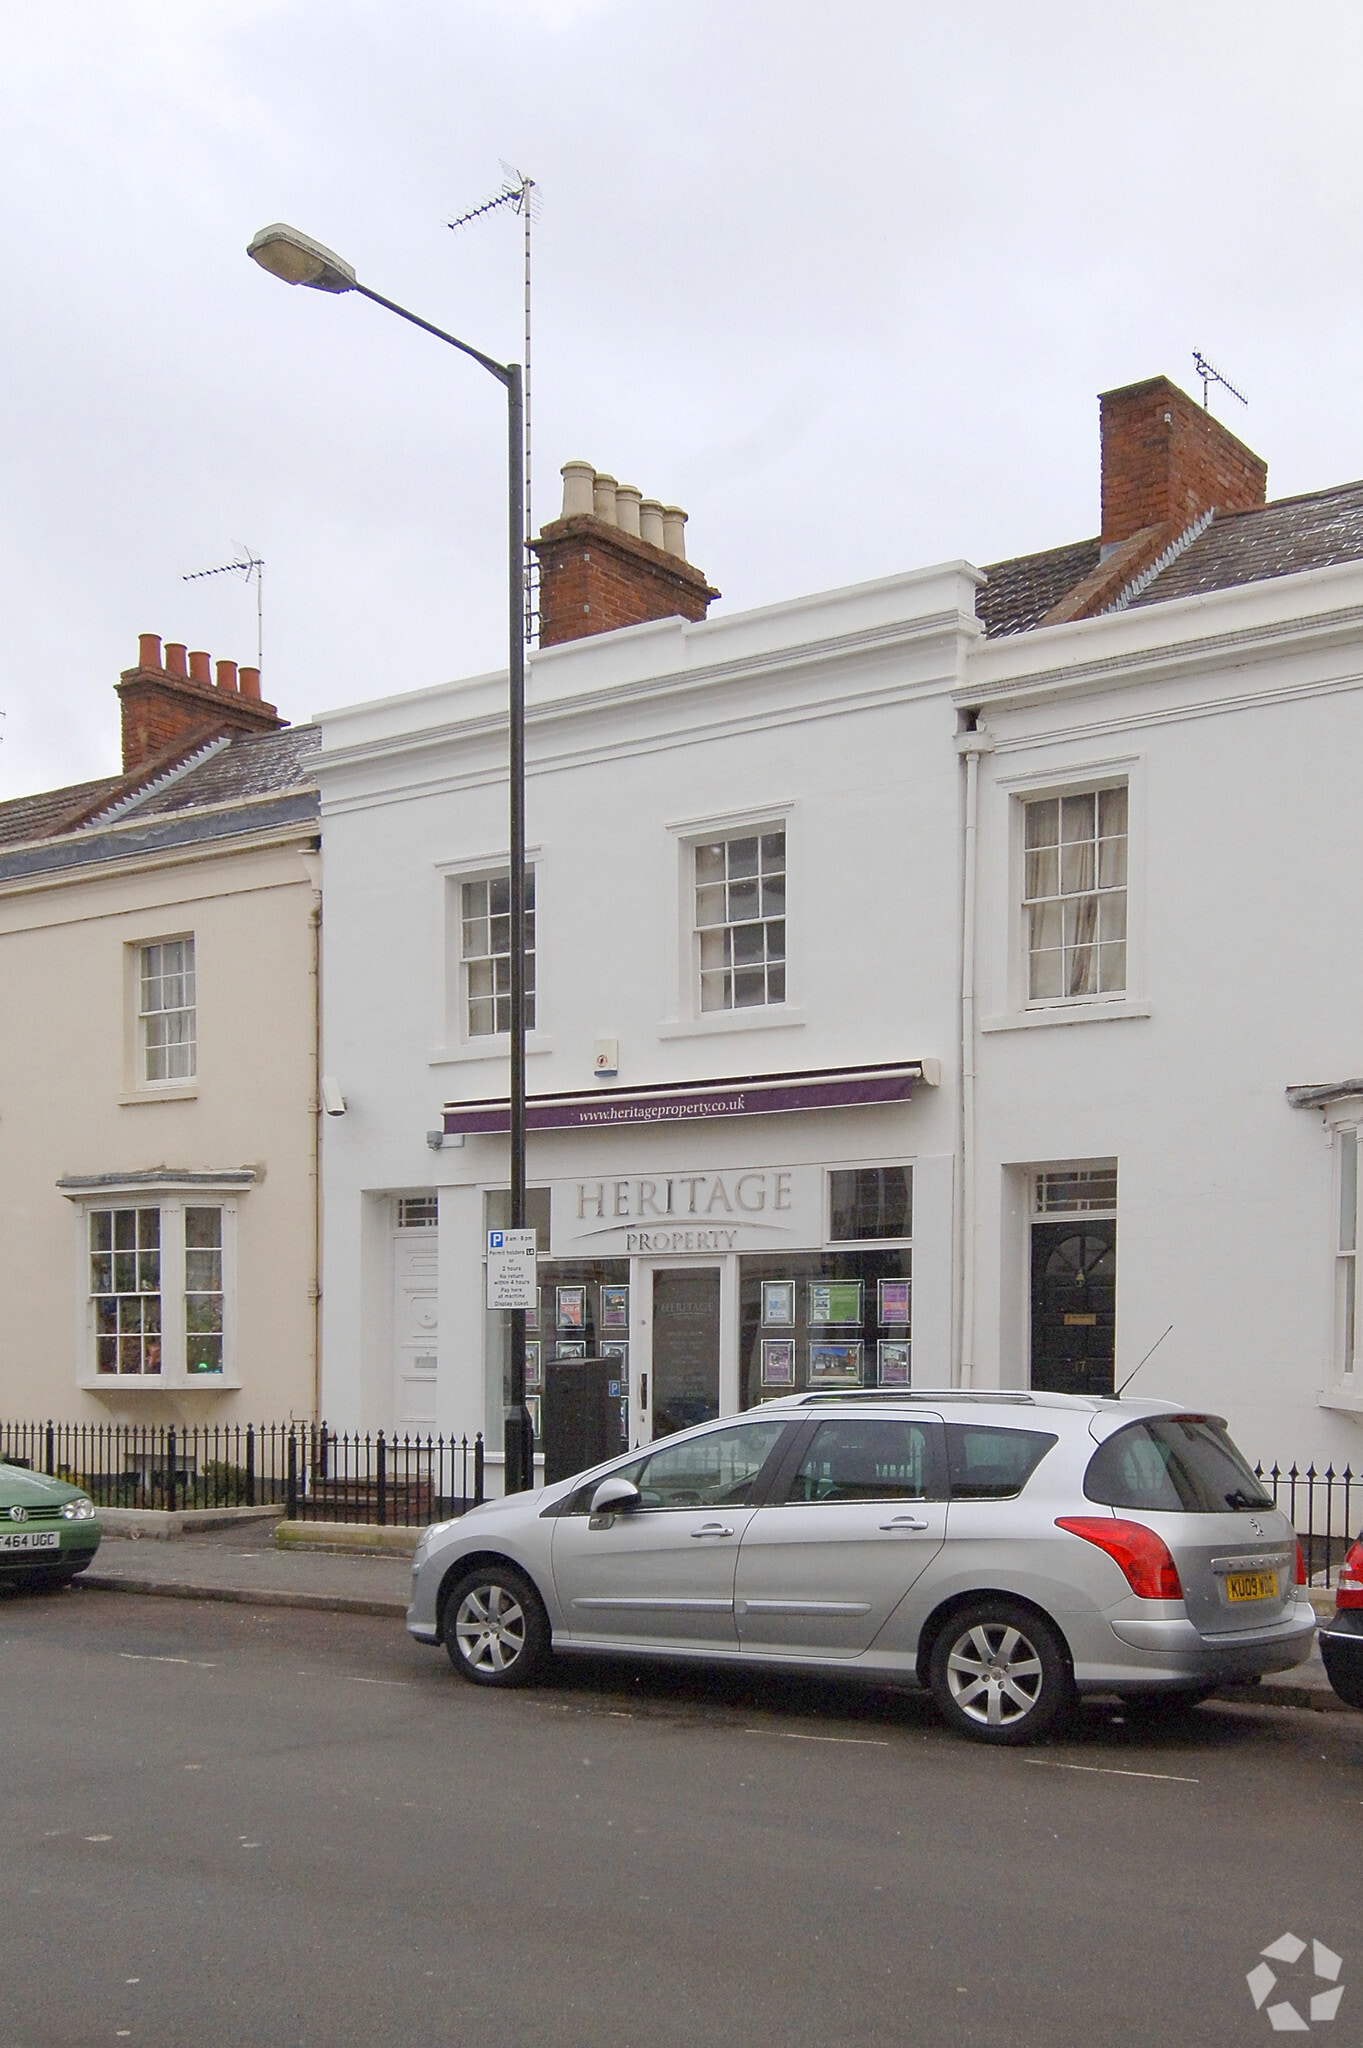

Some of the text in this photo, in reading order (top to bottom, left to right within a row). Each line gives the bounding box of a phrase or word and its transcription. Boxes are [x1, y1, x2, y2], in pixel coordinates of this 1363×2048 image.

[579, 1097, 745, 1121] www.heritageproperty.co.uk
[576, 1172, 792, 1219] HERITAGE
[626, 1229, 738, 1250] PROPERTY
[32, 1533, 54, 1547] UGC
[1231, 1577, 1258, 1598] KU09
